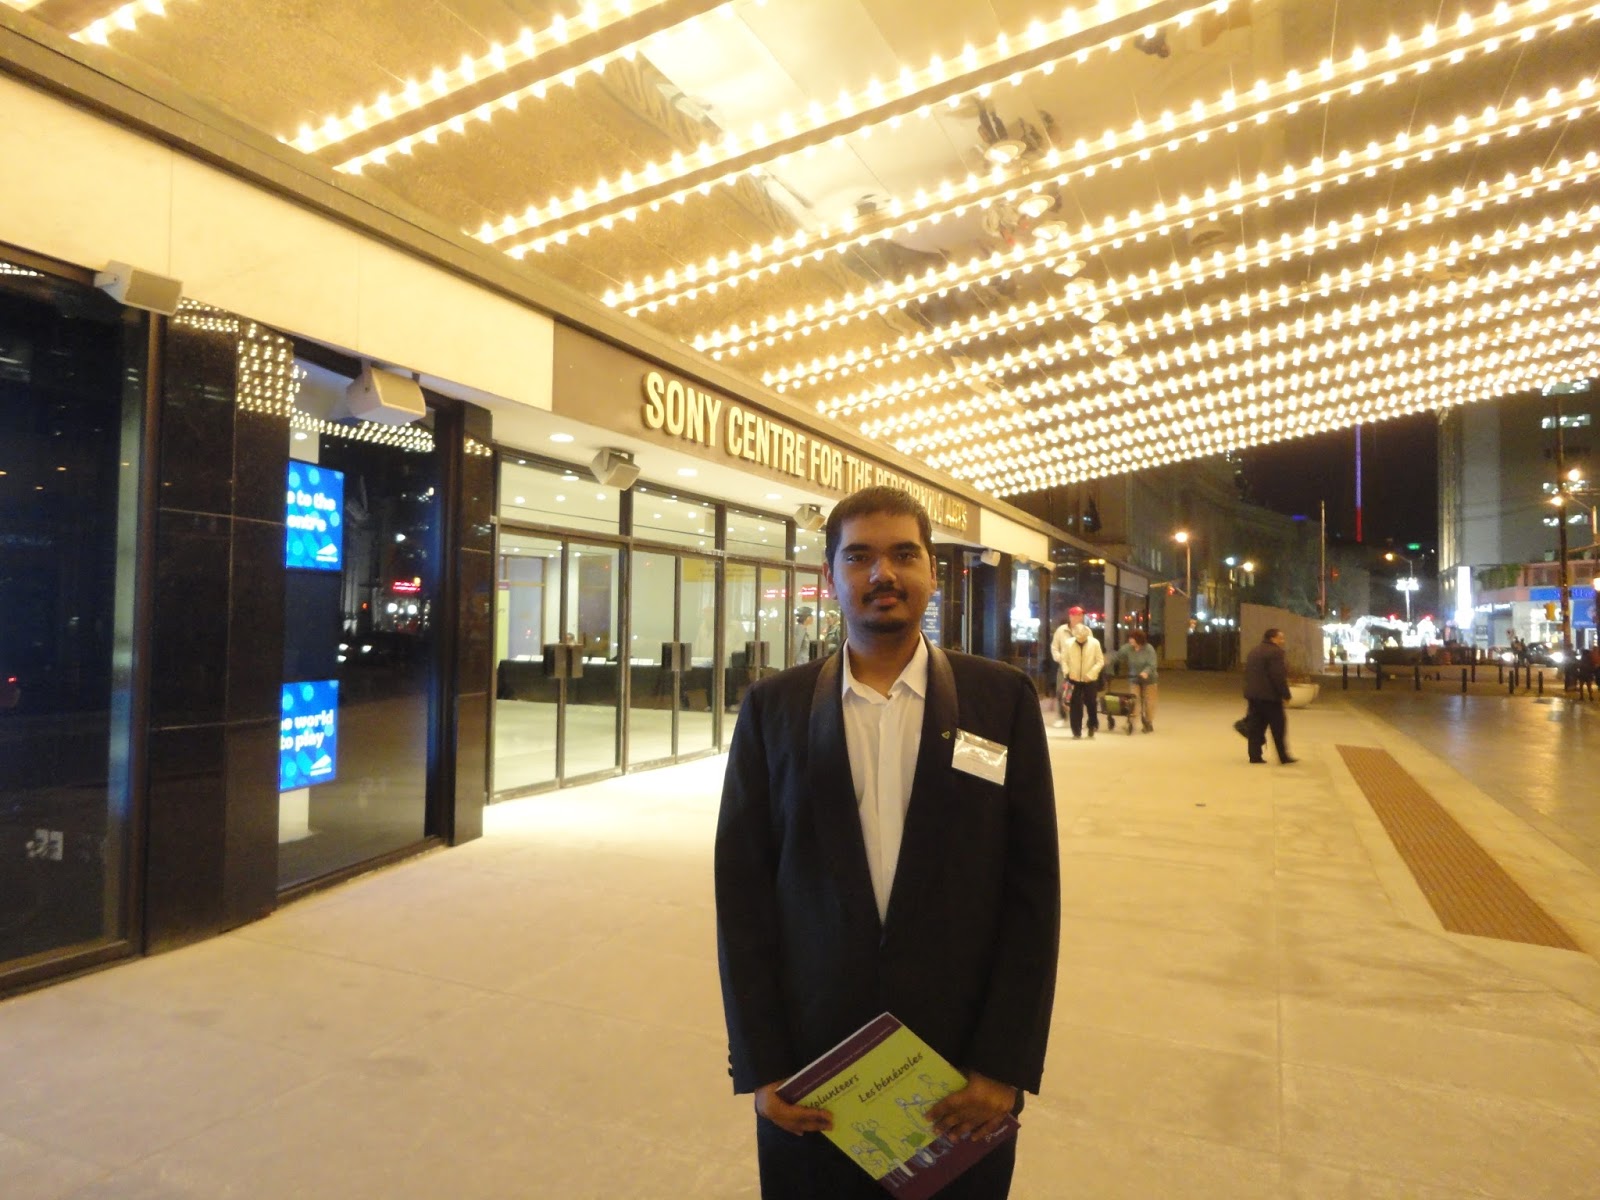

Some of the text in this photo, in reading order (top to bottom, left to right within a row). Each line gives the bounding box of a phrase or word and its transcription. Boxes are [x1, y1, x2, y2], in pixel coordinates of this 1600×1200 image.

[643, 371, 722, 447] SONY
[727, 406, 807, 477] CENTRE
[809, 439, 843, 490] FOR
[846, 454, 873, 494] THE
[297, 490, 312, 507] to
[313, 492, 336, 511] the
[287, 514, 327, 532] entre
[294, 709, 334, 729] world
[280, 729, 325, 752] to play
[858, 1086, 876, 1103] Les
[873, 1051, 924, 1092] bénévoles
